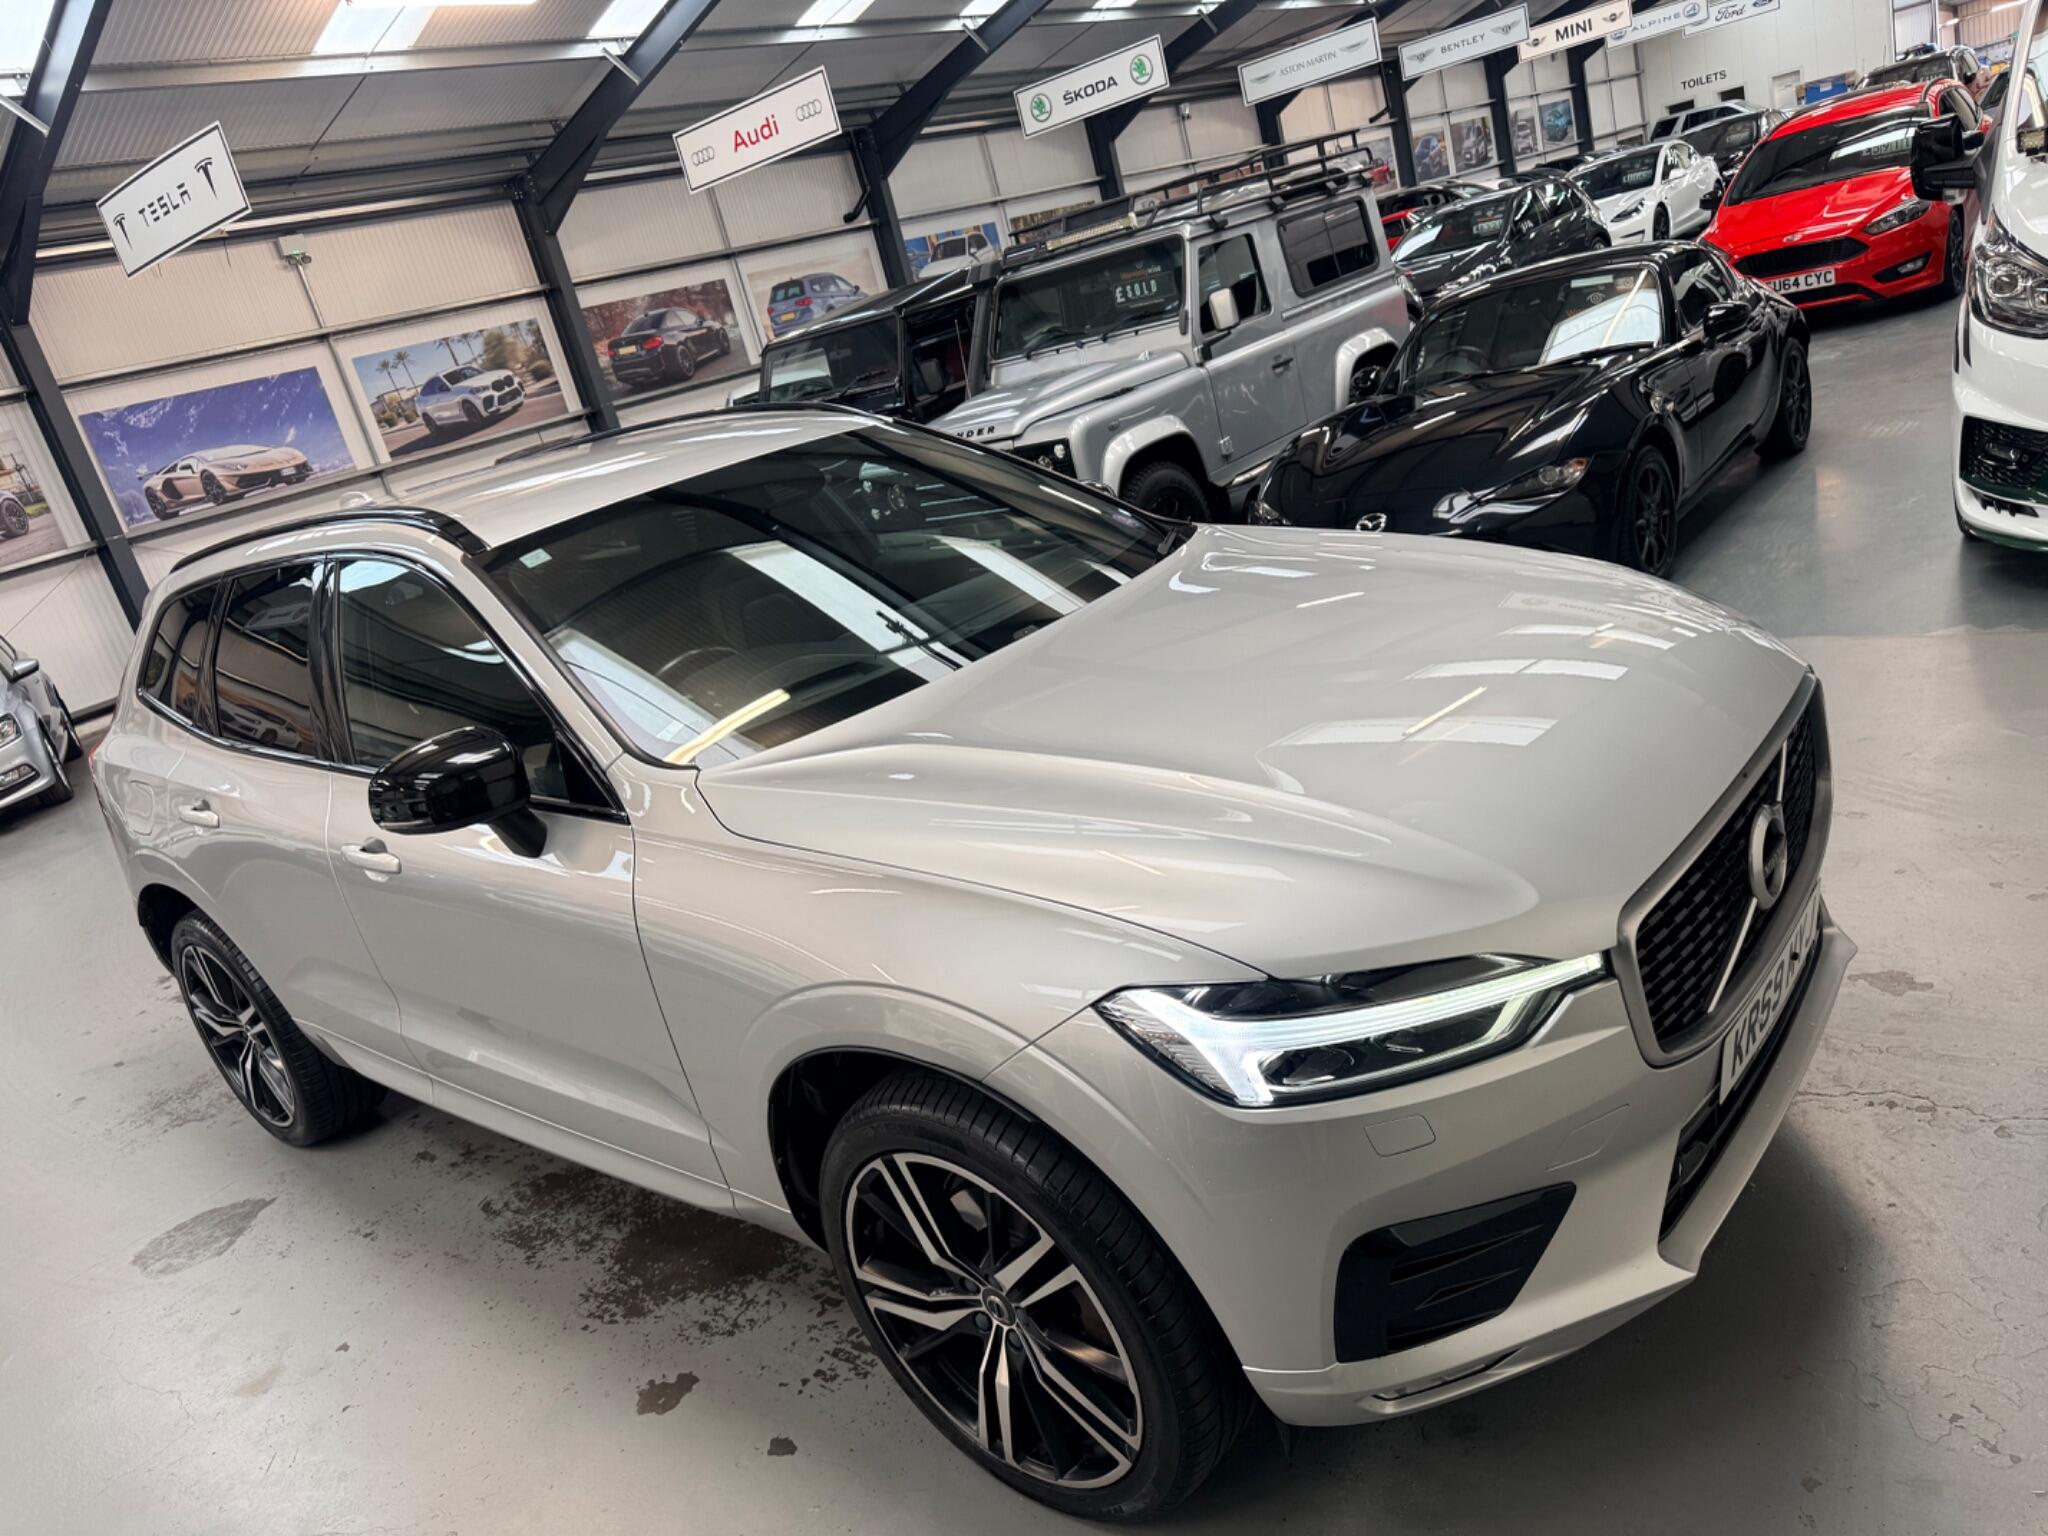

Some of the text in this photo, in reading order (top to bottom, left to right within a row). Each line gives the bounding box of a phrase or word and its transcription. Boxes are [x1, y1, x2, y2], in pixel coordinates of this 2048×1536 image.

[1631, 12, 1682, 33] ALPINE
[1715, 4, 1746, 22] Ford
[1555, 18, 1593, 42] MINI
[1440, 33, 1486, 54] BENTLEY
[1279, 50, 1337, 77] ASTON MARTIN
[1062, 76, 1119, 106] ŠKODA
[1680, 69, 1728, 91] TOILETS
[733, 113, 780, 153] Audi
[138, 182, 192, 228] TESLA
[1767, 270, 1833, 292] U64 CYC
[1730, 958, 1785, 1080] KR59
